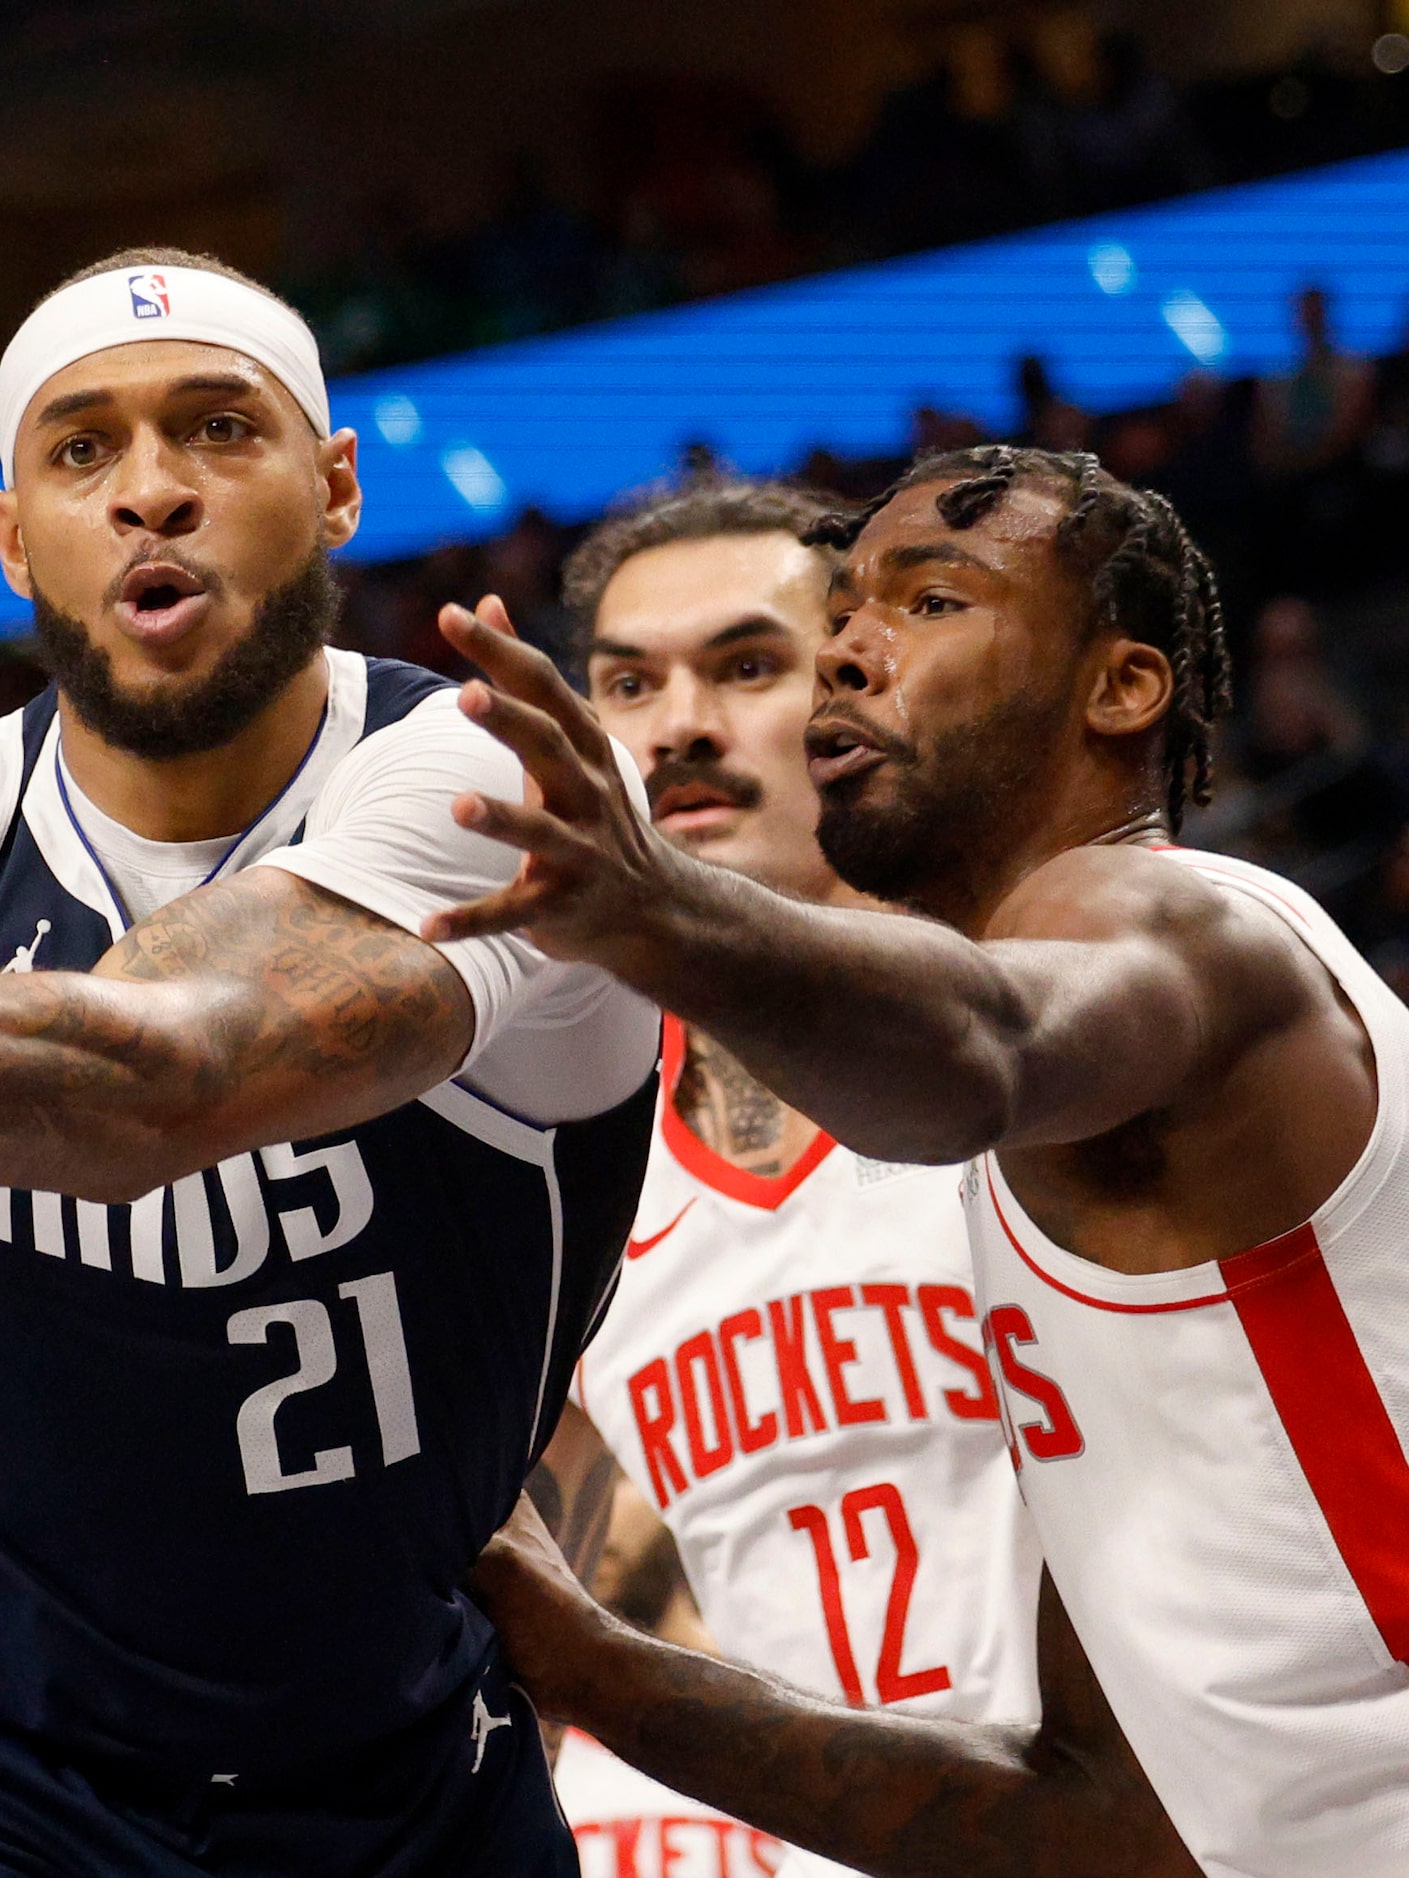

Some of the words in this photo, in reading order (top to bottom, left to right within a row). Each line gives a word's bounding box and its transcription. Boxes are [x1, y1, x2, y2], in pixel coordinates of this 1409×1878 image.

[136, 303, 158, 317] NBA
[227, 1271, 421, 1496] 21
[626, 1281, 1002, 1511] ROCKETS
[787, 1481, 953, 1710] 12
